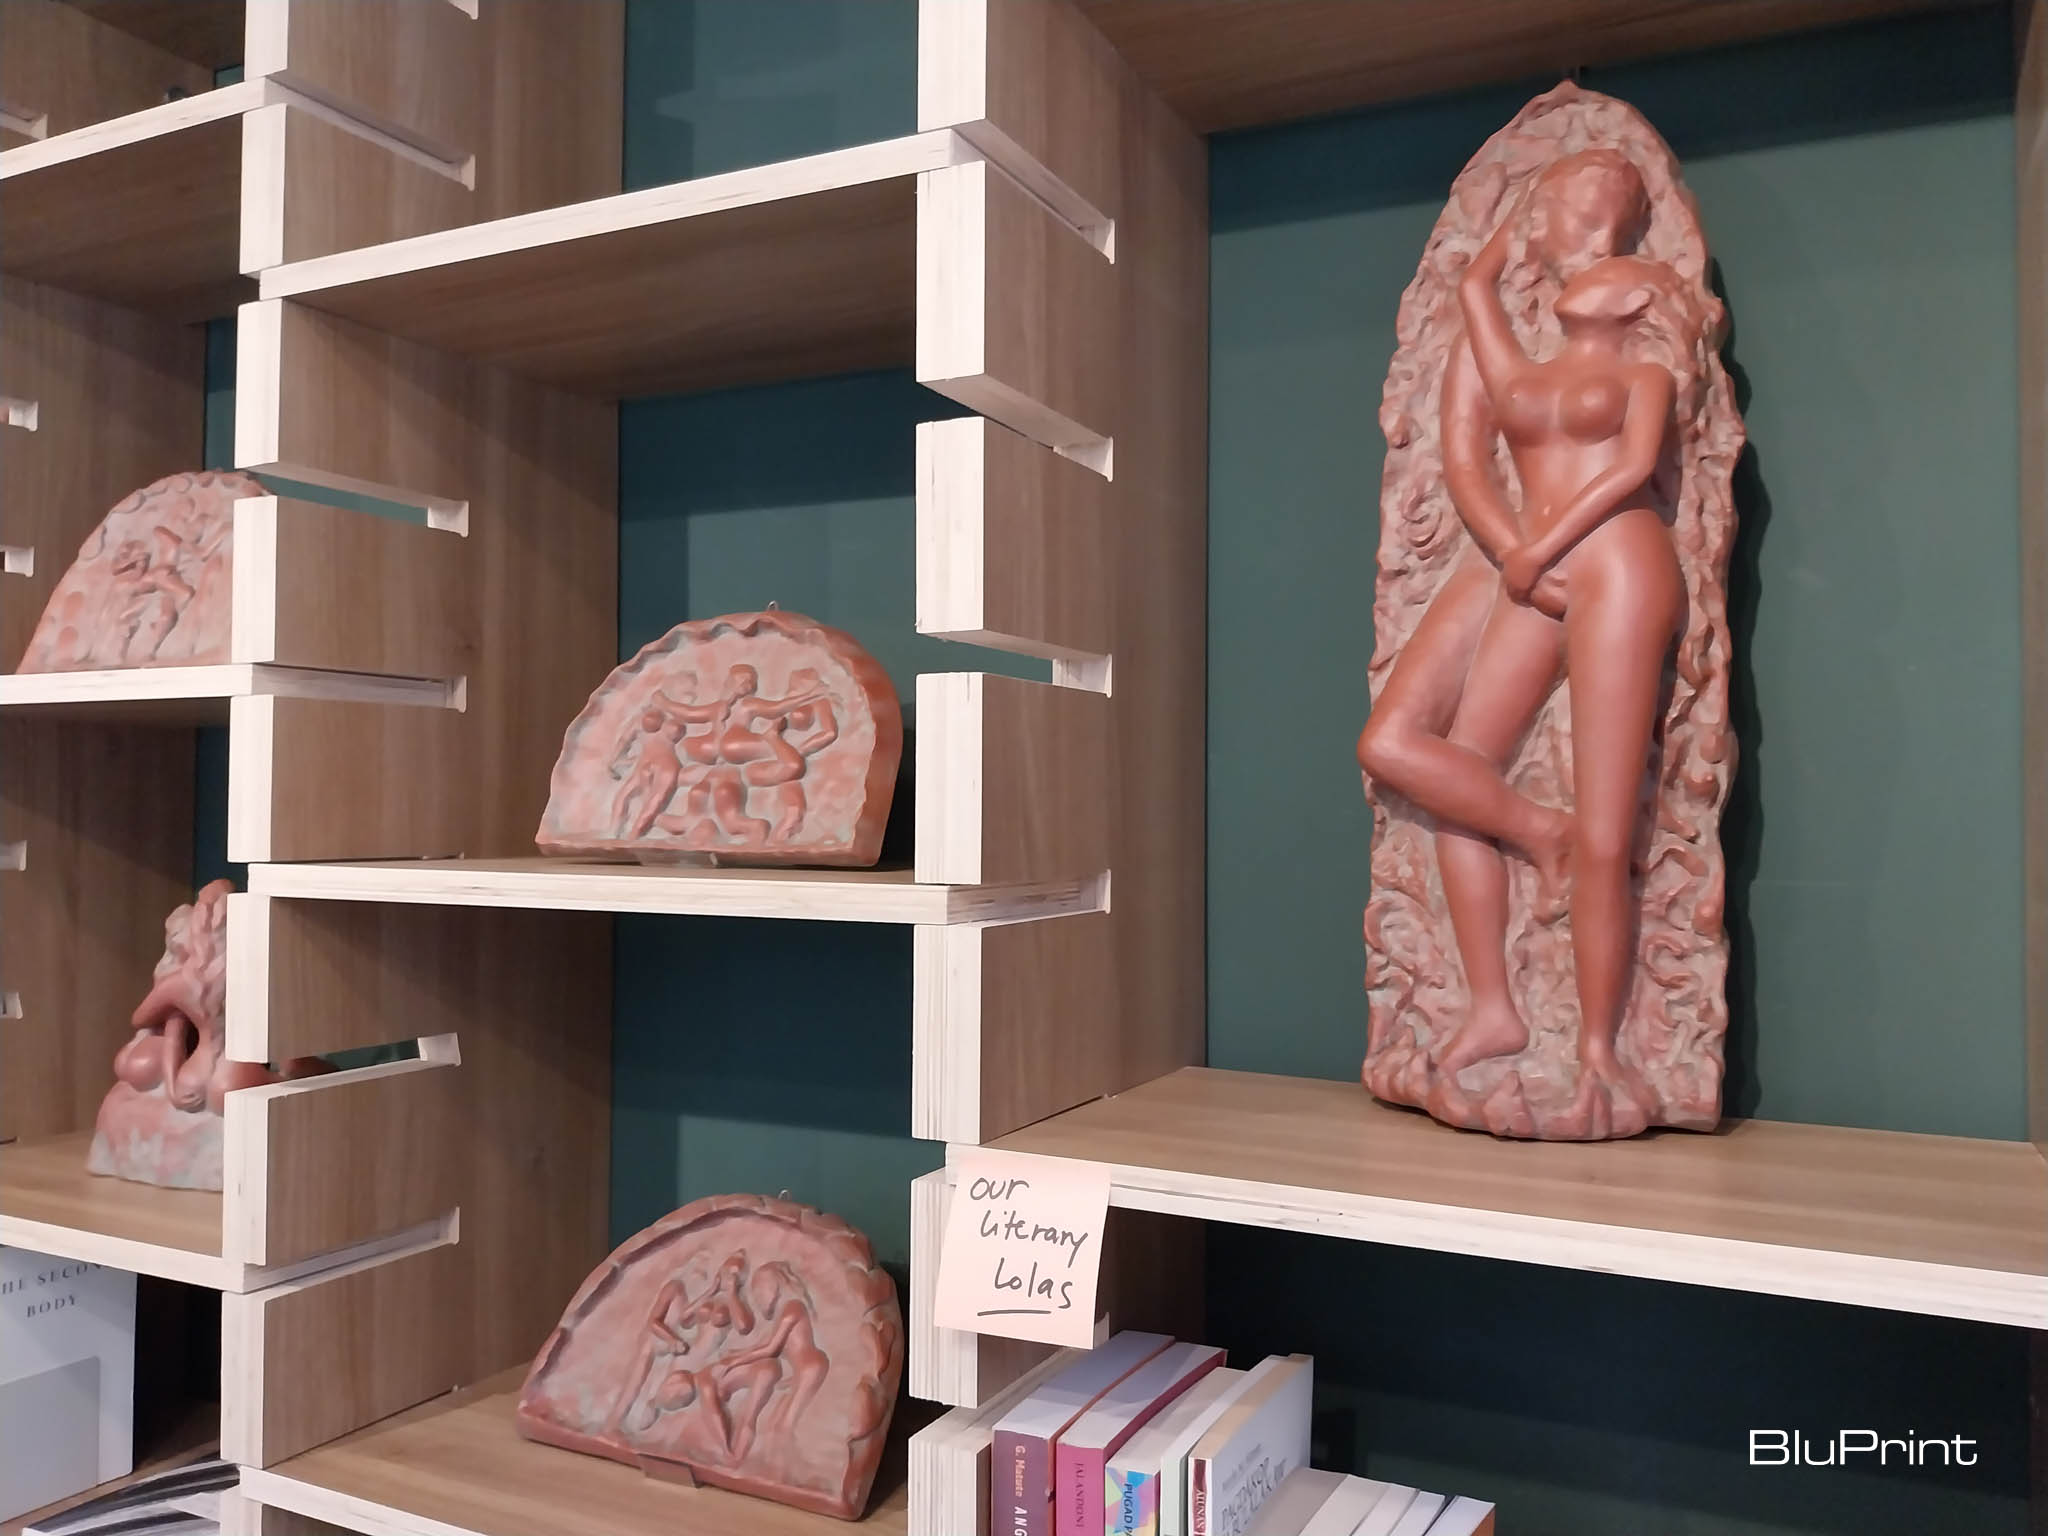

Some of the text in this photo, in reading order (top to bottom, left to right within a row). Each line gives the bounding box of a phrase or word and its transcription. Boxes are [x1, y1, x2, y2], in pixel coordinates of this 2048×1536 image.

[970, 1177, 1030, 1201] our
[980, 1210, 1088, 1268] literary
[1, 1262, 101, 1295] HE SECO
[27, 1294, 76, 1318] BODY
[1123, 1483, 1134, 1524] PUGAD
